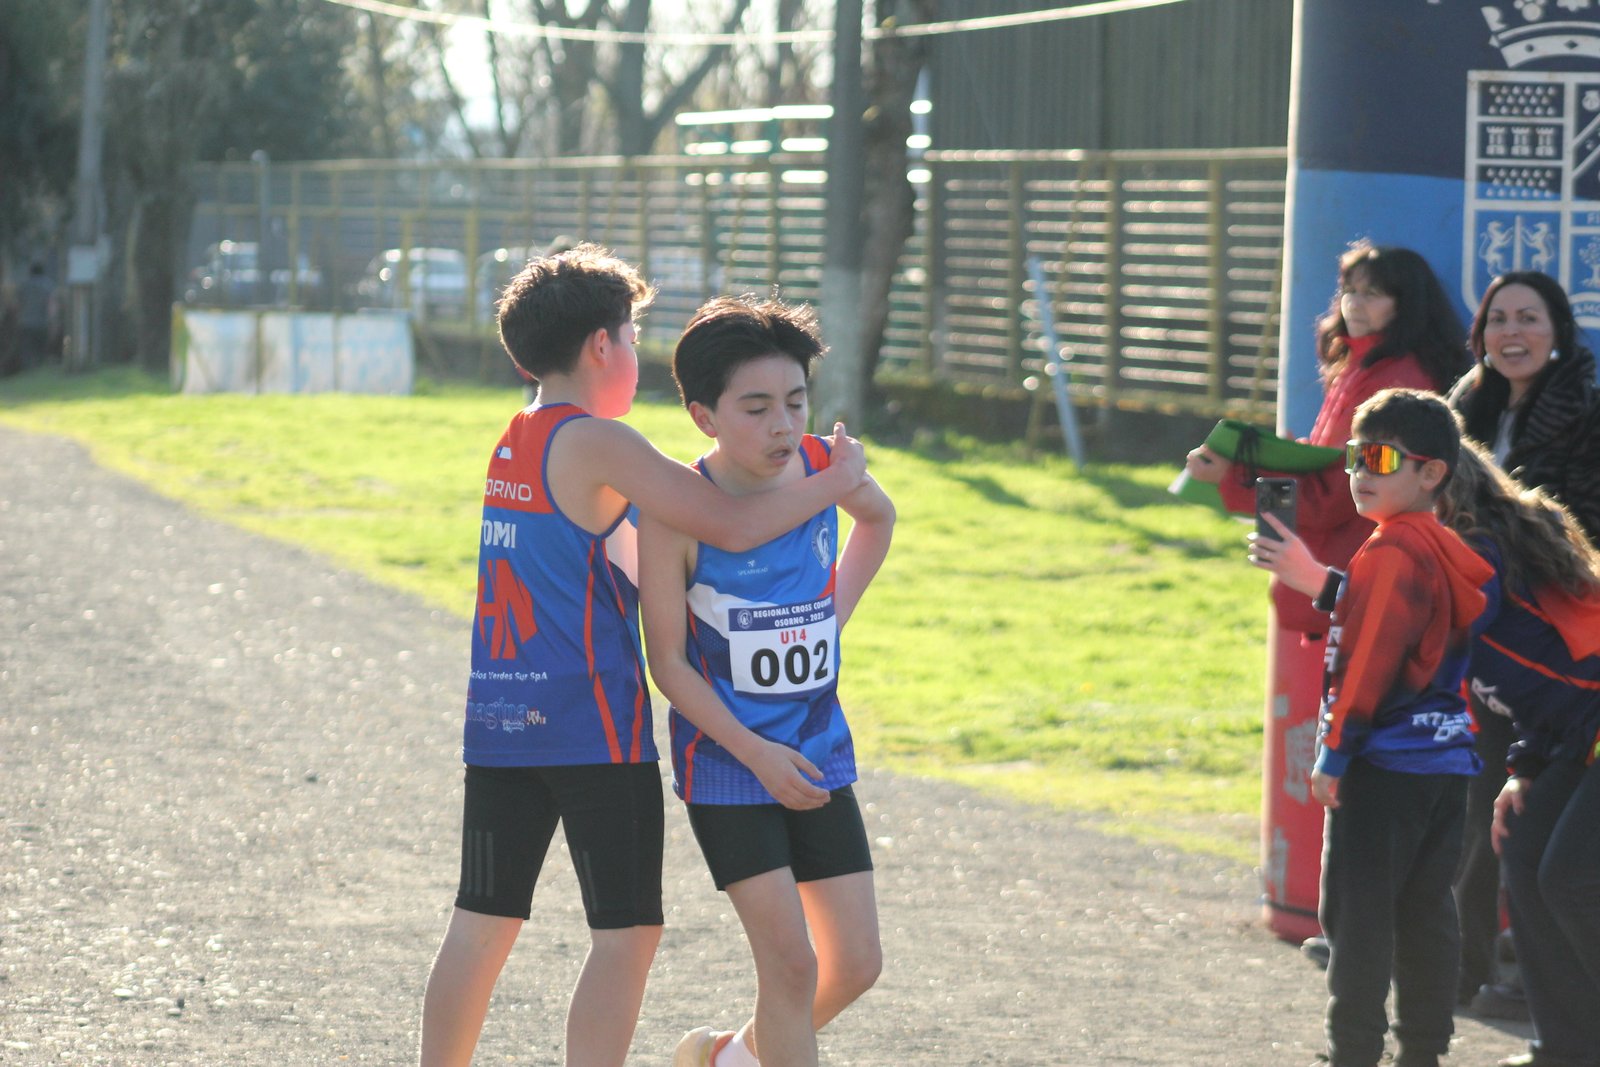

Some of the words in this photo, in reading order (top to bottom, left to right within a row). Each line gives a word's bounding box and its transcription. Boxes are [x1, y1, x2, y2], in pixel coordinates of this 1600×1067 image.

[481, 519, 517, 549] OMI
[753, 607, 789, 618] REGIONAL
[791, 603, 812, 614] CROSS
[774, 616, 804, 627] OSORNO
[780, 628, 807, 644] U14
[751, 639, 828, 687] 002
[488, 671, 513, 680] Verdes
